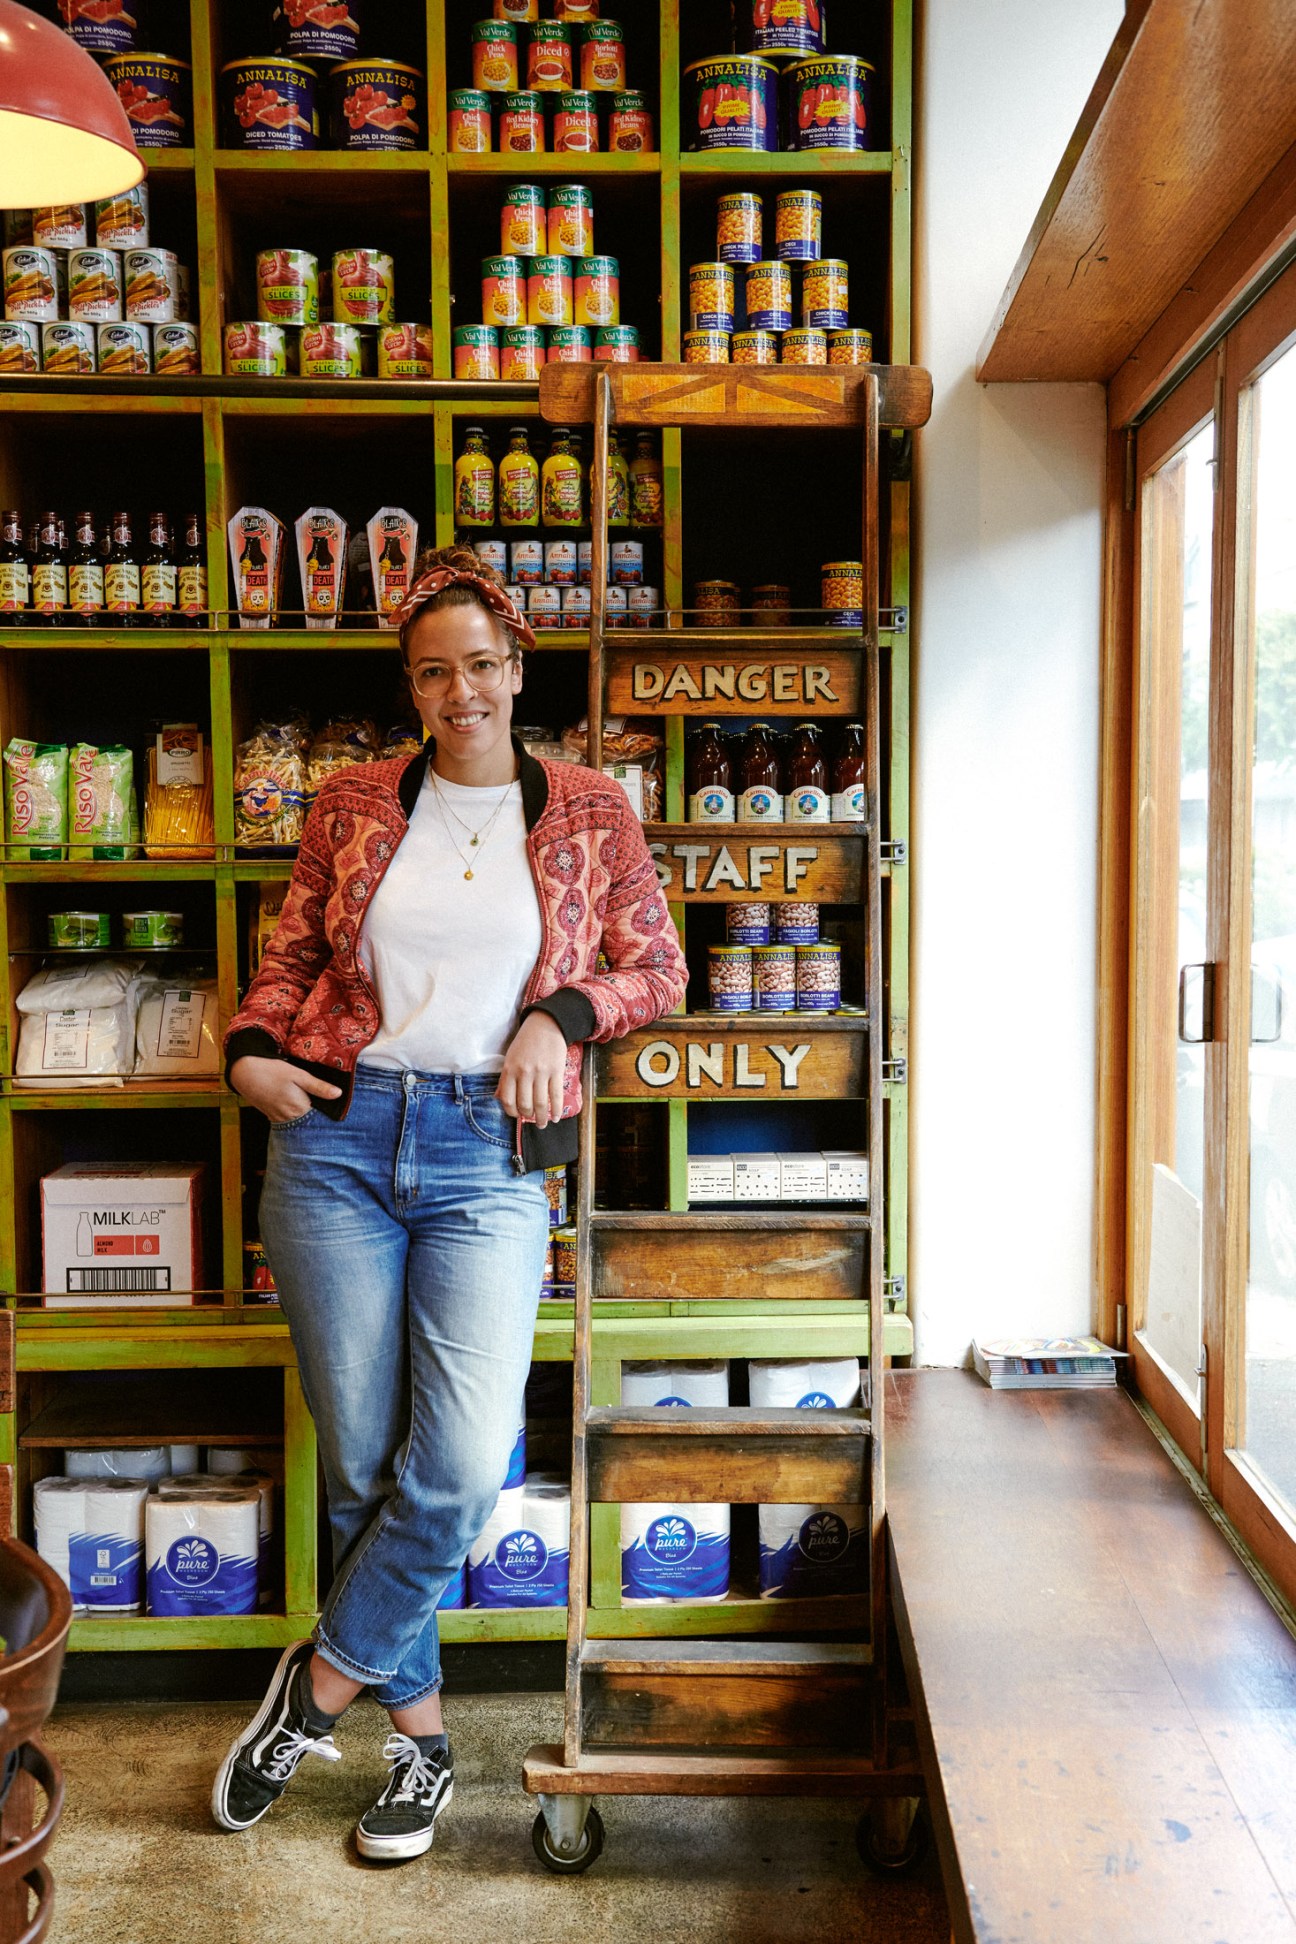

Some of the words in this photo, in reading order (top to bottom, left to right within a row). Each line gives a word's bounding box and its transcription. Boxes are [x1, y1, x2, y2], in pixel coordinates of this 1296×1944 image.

[93, 26, 132, 39] POMODORO
[290, 31, 311, 39] POLPA
[320, 32, 356, 44] POMODORO
[480, 29, 490, 37] Val
[490, 29, 511, 38] Verde
[533, 29, 543, 37] Val
[543, 29, 564, 38] Verde
[590, 28, 601, 37] Val
[601, 29, 620, 38] Verde
[486, 44, 506, 52] Chick
[536, 46, 562, 56] Diced
[488, 51, 504, 59] Peas
[597, 51, 616, 59] Beans
[109, 65, 180, 83] ANNALISA
[696, 63, 767, 81] ANNALISA
[796, 63, 867, 81] ANNALISA
[236, 69, 307, 89] ANNALISA
[346, 72, 416, 91] ANNALISA
[455, 97, 467, 105] Val
[467, 97, 486, 106] Verde
[506, 98, 518, 106] Val
[517, 98, 537, 107] Verde
[562, 98, 573, 106] Val
[573, 98, 593, 107] Verde
[613, 98, 625, 106] Val
[625, 98, 644, 106] Verde
[462, 113, 481, 122] Chick
[506, 115, 518, 123] Red
[518, 114, 539, 126] Kidney
[565, 117, 591, 126] Diced
[613, 115, 624, 123] Red
[624, 115, 646, 124] Kidney
[513, 120, 532, 129] Beans
[620, 121, 640, 129] Beans
[140, 127, 180, 138] POMODORO
[267, 131, 302, 141] TOMATOES
[379, 134, 415, 145] POMODORO
[507, 192, 519, 200] Val
[519, 192, 539, 201] Verde
[556, 193, 568, 202] Val
[568, 193, 588, 202] Verde
[718, 200, 760, 211] ANNALISA
[776, 198, 817, 208] ANNALISA
[490, 264, 502, 272] Val
[502, 264, 521, 273] Verde
[535, 262, 547, 271] Val
[547, 263, 567, 272] Verde
[583, 262, 595, 271] Val
[595, 263, 615, 273] Verde
[268, 291, 300, 299] SLICES
[348, 291, 380, 299] SLICES
[464, 332, 476, 341] Val
[476, 333, 496, 342] Verde
[507, 333, 519, 342] Val
[519, 334, 539, 343] Verde
[552, 332, 563, 341] Val
[563, 332, 584, 342] Verde
[603, 332, 615, 341] Val
[615, 332, 635, 342] Verde
[733, 338, 773, 349] ANNALISA
[313, 364, 345, 373] SLICES
[395, 365, 427, 374] SLICES
[241, 517, 268, 528] BLAIR'S
[308, 517, 335, 528] BLAIR'S
[516, 552, 543, 560] Annalisa
[550, 552, 576, 560] Annalisa
[247, 575, 268, 585] DEATH
[313, 575, 334, 585] DEATH
[385, 575, 406, 585] DEATH
[633, 664, 839, 703] DANGER
[699, 789, 728, 799] Carmelina
[746, 789, 775, 800] Carmelina
[793, 789, 823, 799] Carmelina
[12, 789, 32, 836] Riso
[74, 787, 98, 835] Riso
[648, 843, 818, 894] STAFF
[797, 952, 838, 960] ANNALISA
[636, 1040, 812, 1090] ONLY
[655, 1538, 688, 1551] pure
[808, 1535, 840, 1550] pure
[176, 1560, 209, 1572] pure
[505, 1555, 538, 1567] pure
